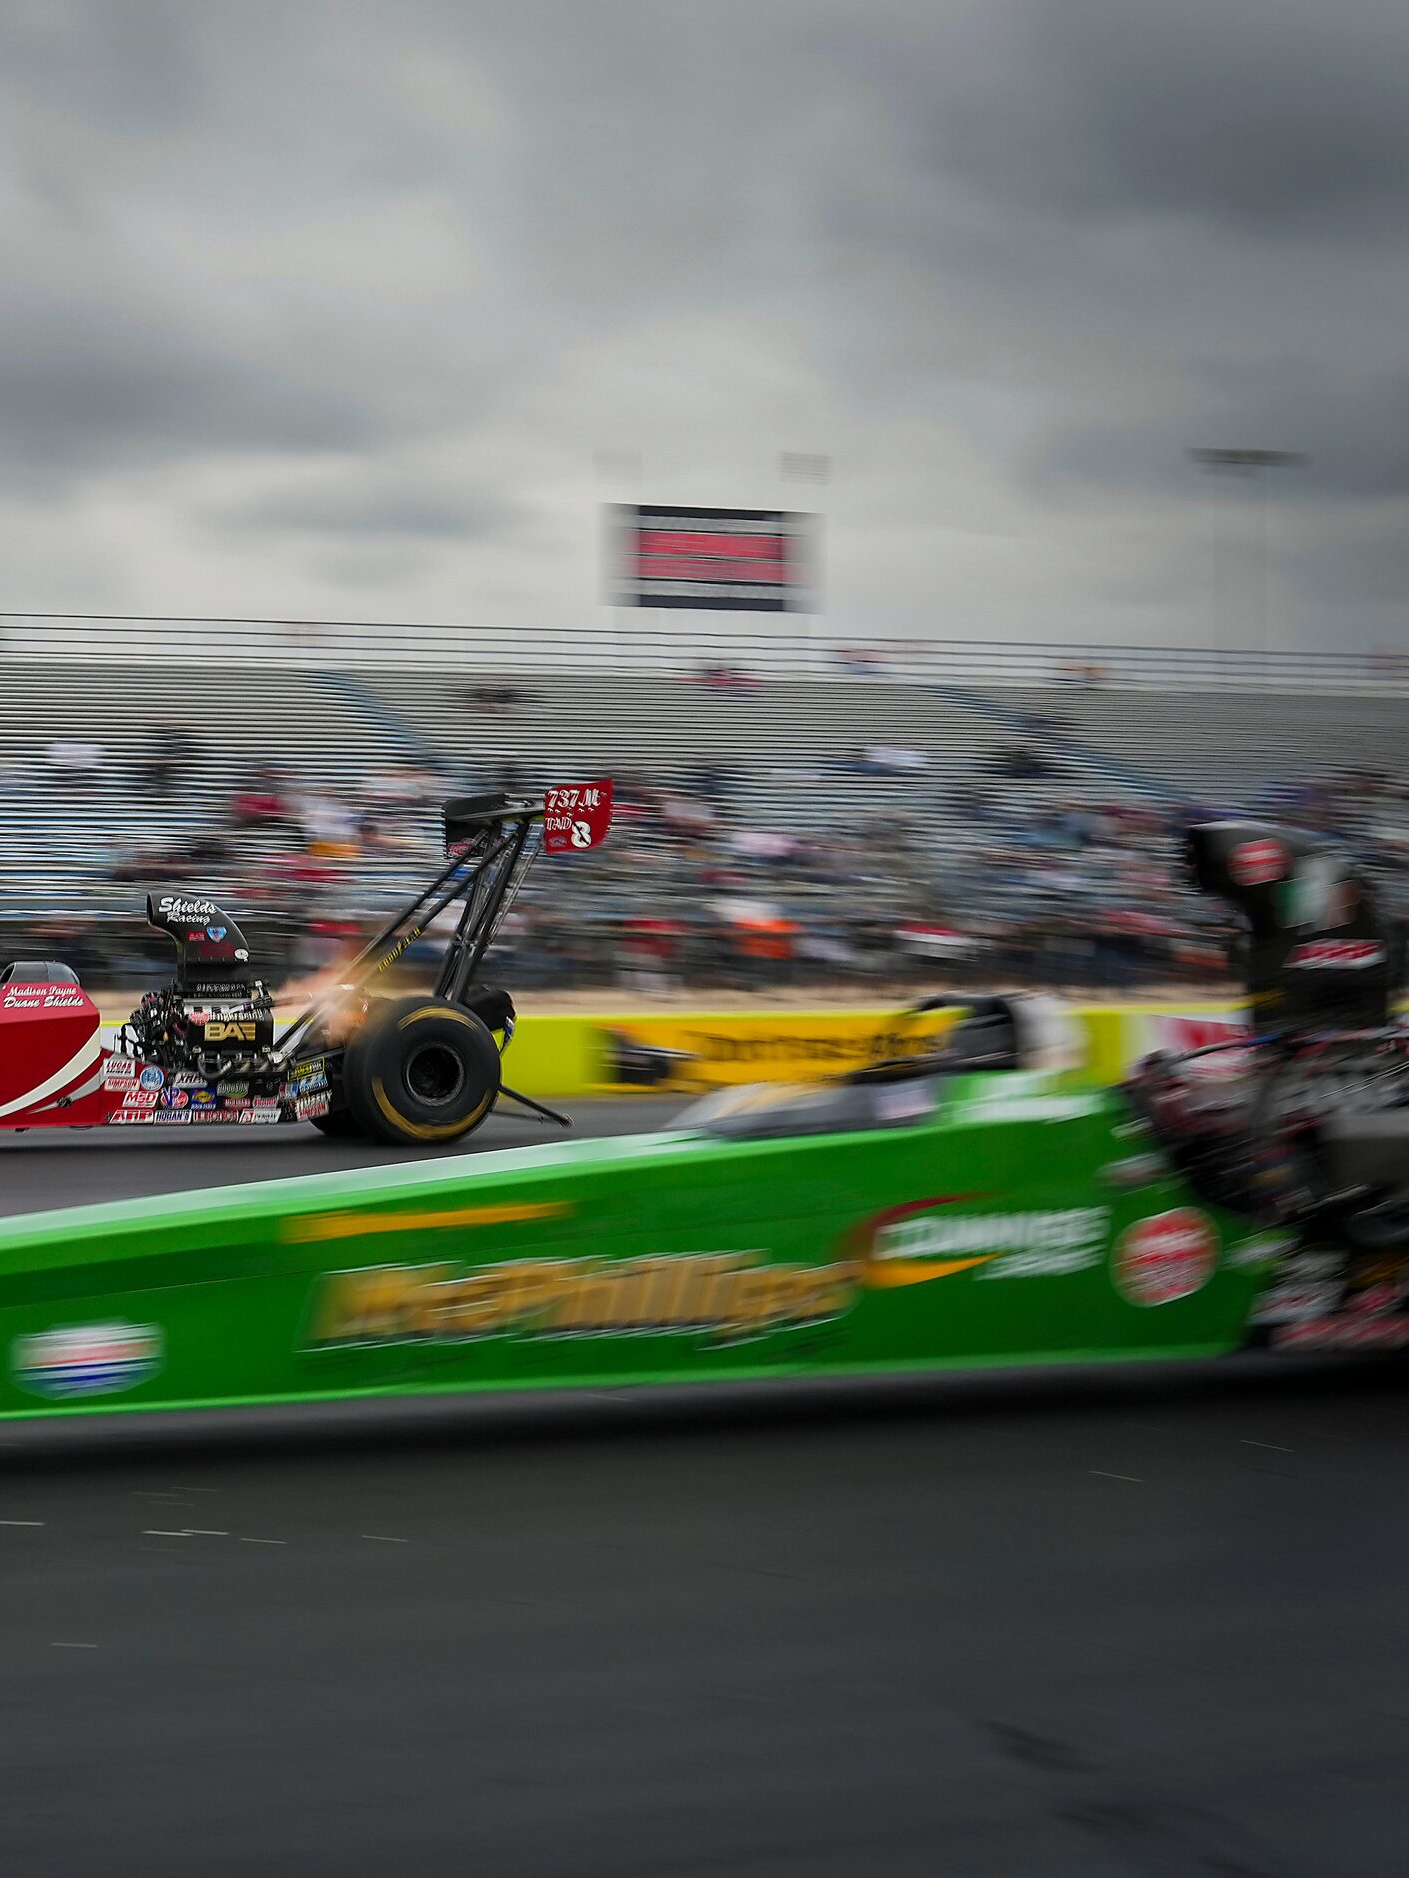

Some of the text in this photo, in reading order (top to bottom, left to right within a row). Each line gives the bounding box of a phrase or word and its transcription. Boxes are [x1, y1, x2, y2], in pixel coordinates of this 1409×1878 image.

[571, 821, 591, 848] 8
[159, 897, 217, 914] Shields
[167, 912, 211, 925] Racing
[7, 985, 76, 998] Madison Payne
[3, 996, 84, 1008] Duane Shields
[204, 1022, 256, 1041] BAE
[106, 1061, 132, 1070] LUCAS
[107, 1079, 137, 1087] SIMPSON
[128, 1091, 156, 1103] MSD
[112, 1111, 152, 1121] ARP
[156, 1111, 189, 1121] HOGAN'S
